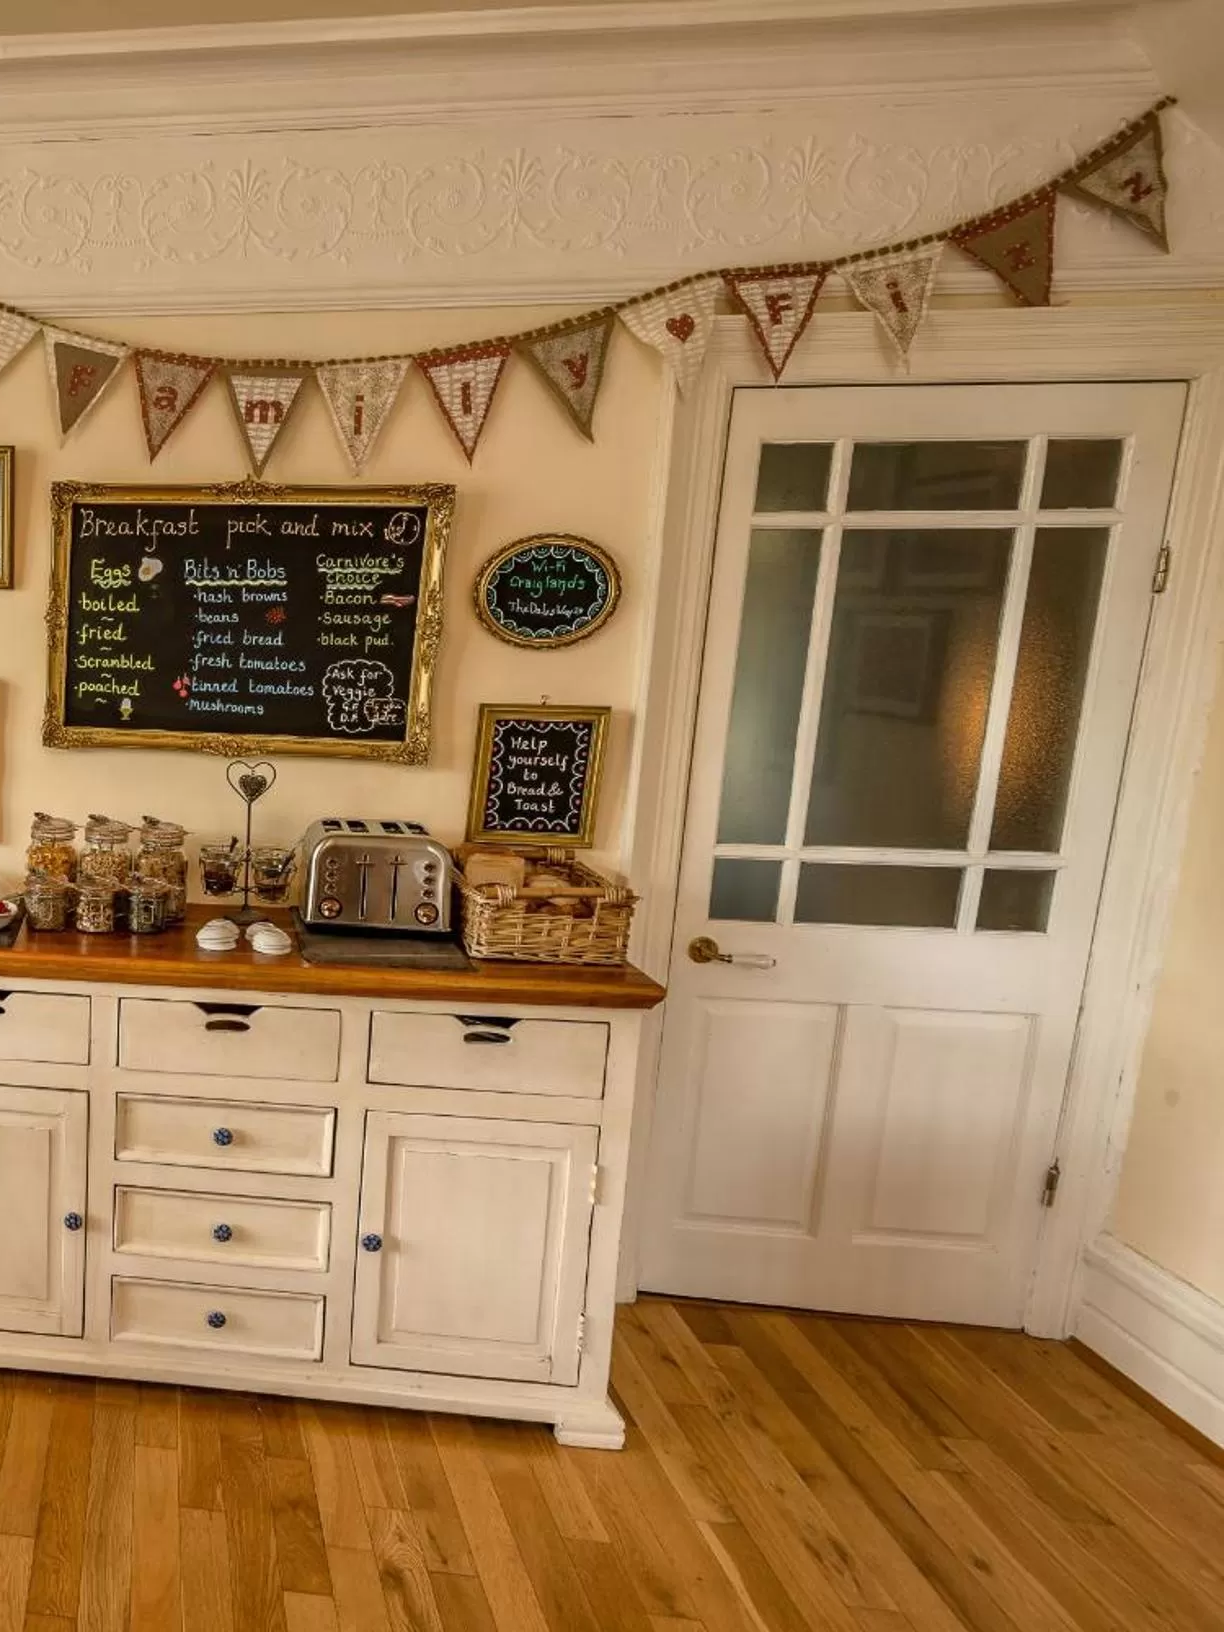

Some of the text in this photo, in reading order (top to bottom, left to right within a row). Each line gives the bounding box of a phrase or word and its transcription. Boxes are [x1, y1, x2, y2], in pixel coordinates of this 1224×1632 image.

[80, 508, 374, 552] Breakfast pick and mix
[91, 558, 131, 588] Eggs
[184, 557, 221, 579] Bits
[247, 558, 286, 579] Bobs
[531, 560, 566, 572] Wi-Fi
[81, 592, 140, 611] boiled
[198, 587, 288, 603] hash browns
[325, 591, 376, 605] Bacon
[198, 607, 239, 623] beans
[78, 622, 128, 645] fried
[193, 629, 285, 648] fried bread
[320, 632, 358, 646] black
[192, 652, 306, 672] fresh tomatoes
[191, 676, 314, 696] tinned tomatoes
[332, 667, 383, 686] Ask for
[79, 677, 140, 698] poached
[511, 736, 548, 755] Help
[507, 752, 569, 772] yourself
[523, 768, 538, 780] to
[507, 781, 545, 796] Bread
[514, 798, 556, 813] Toast
